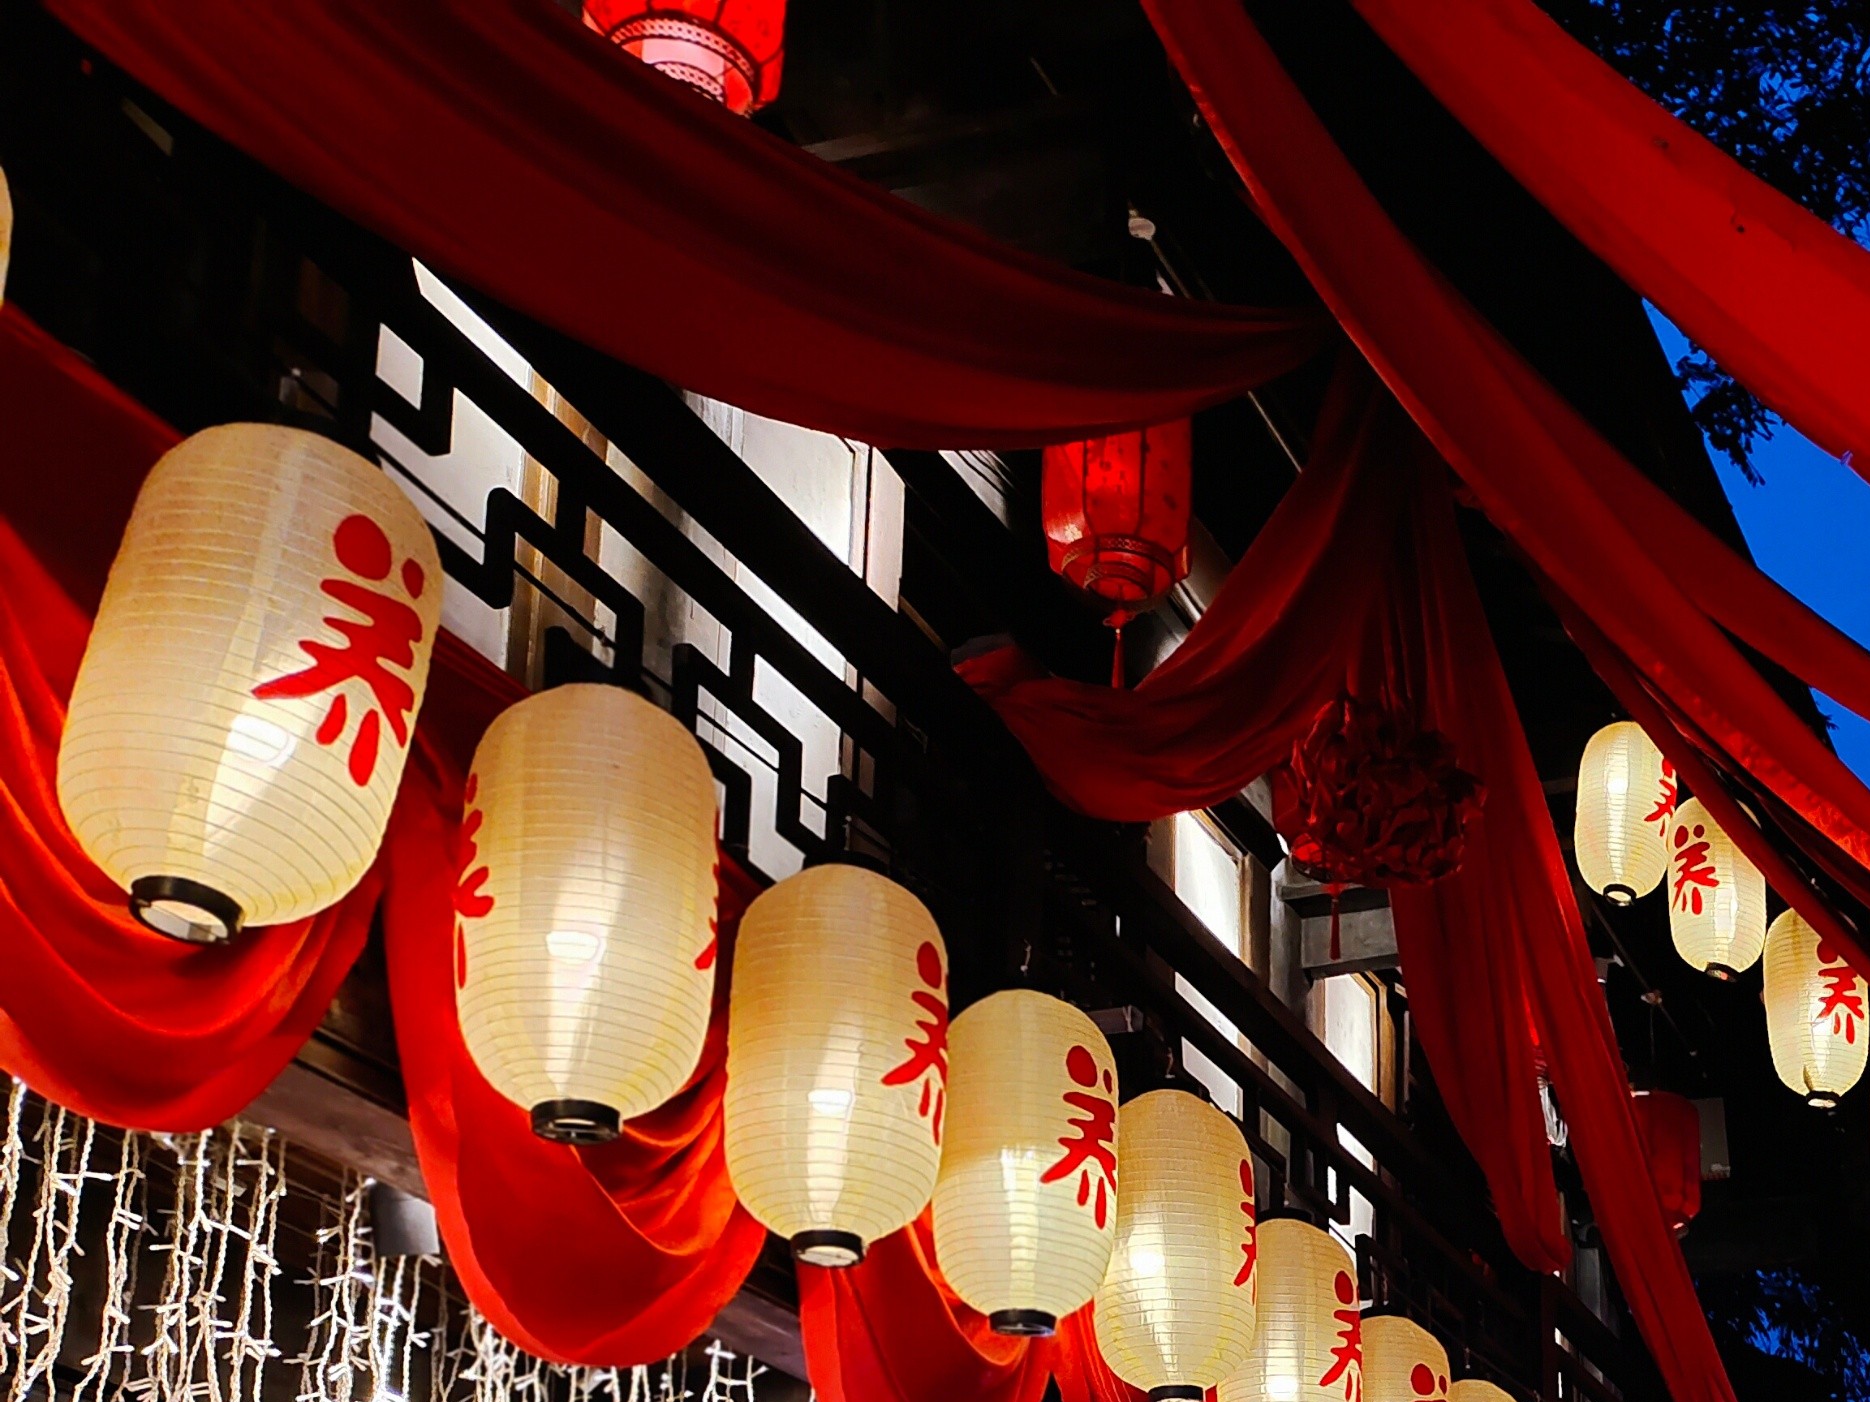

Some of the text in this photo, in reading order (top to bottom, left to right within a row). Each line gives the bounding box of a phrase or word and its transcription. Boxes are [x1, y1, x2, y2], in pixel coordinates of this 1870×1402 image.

[252, 514, 424, 787] 养
[1673, 825, 1719, 915] 养
[1040, 1046, 1118, 1230] 养
